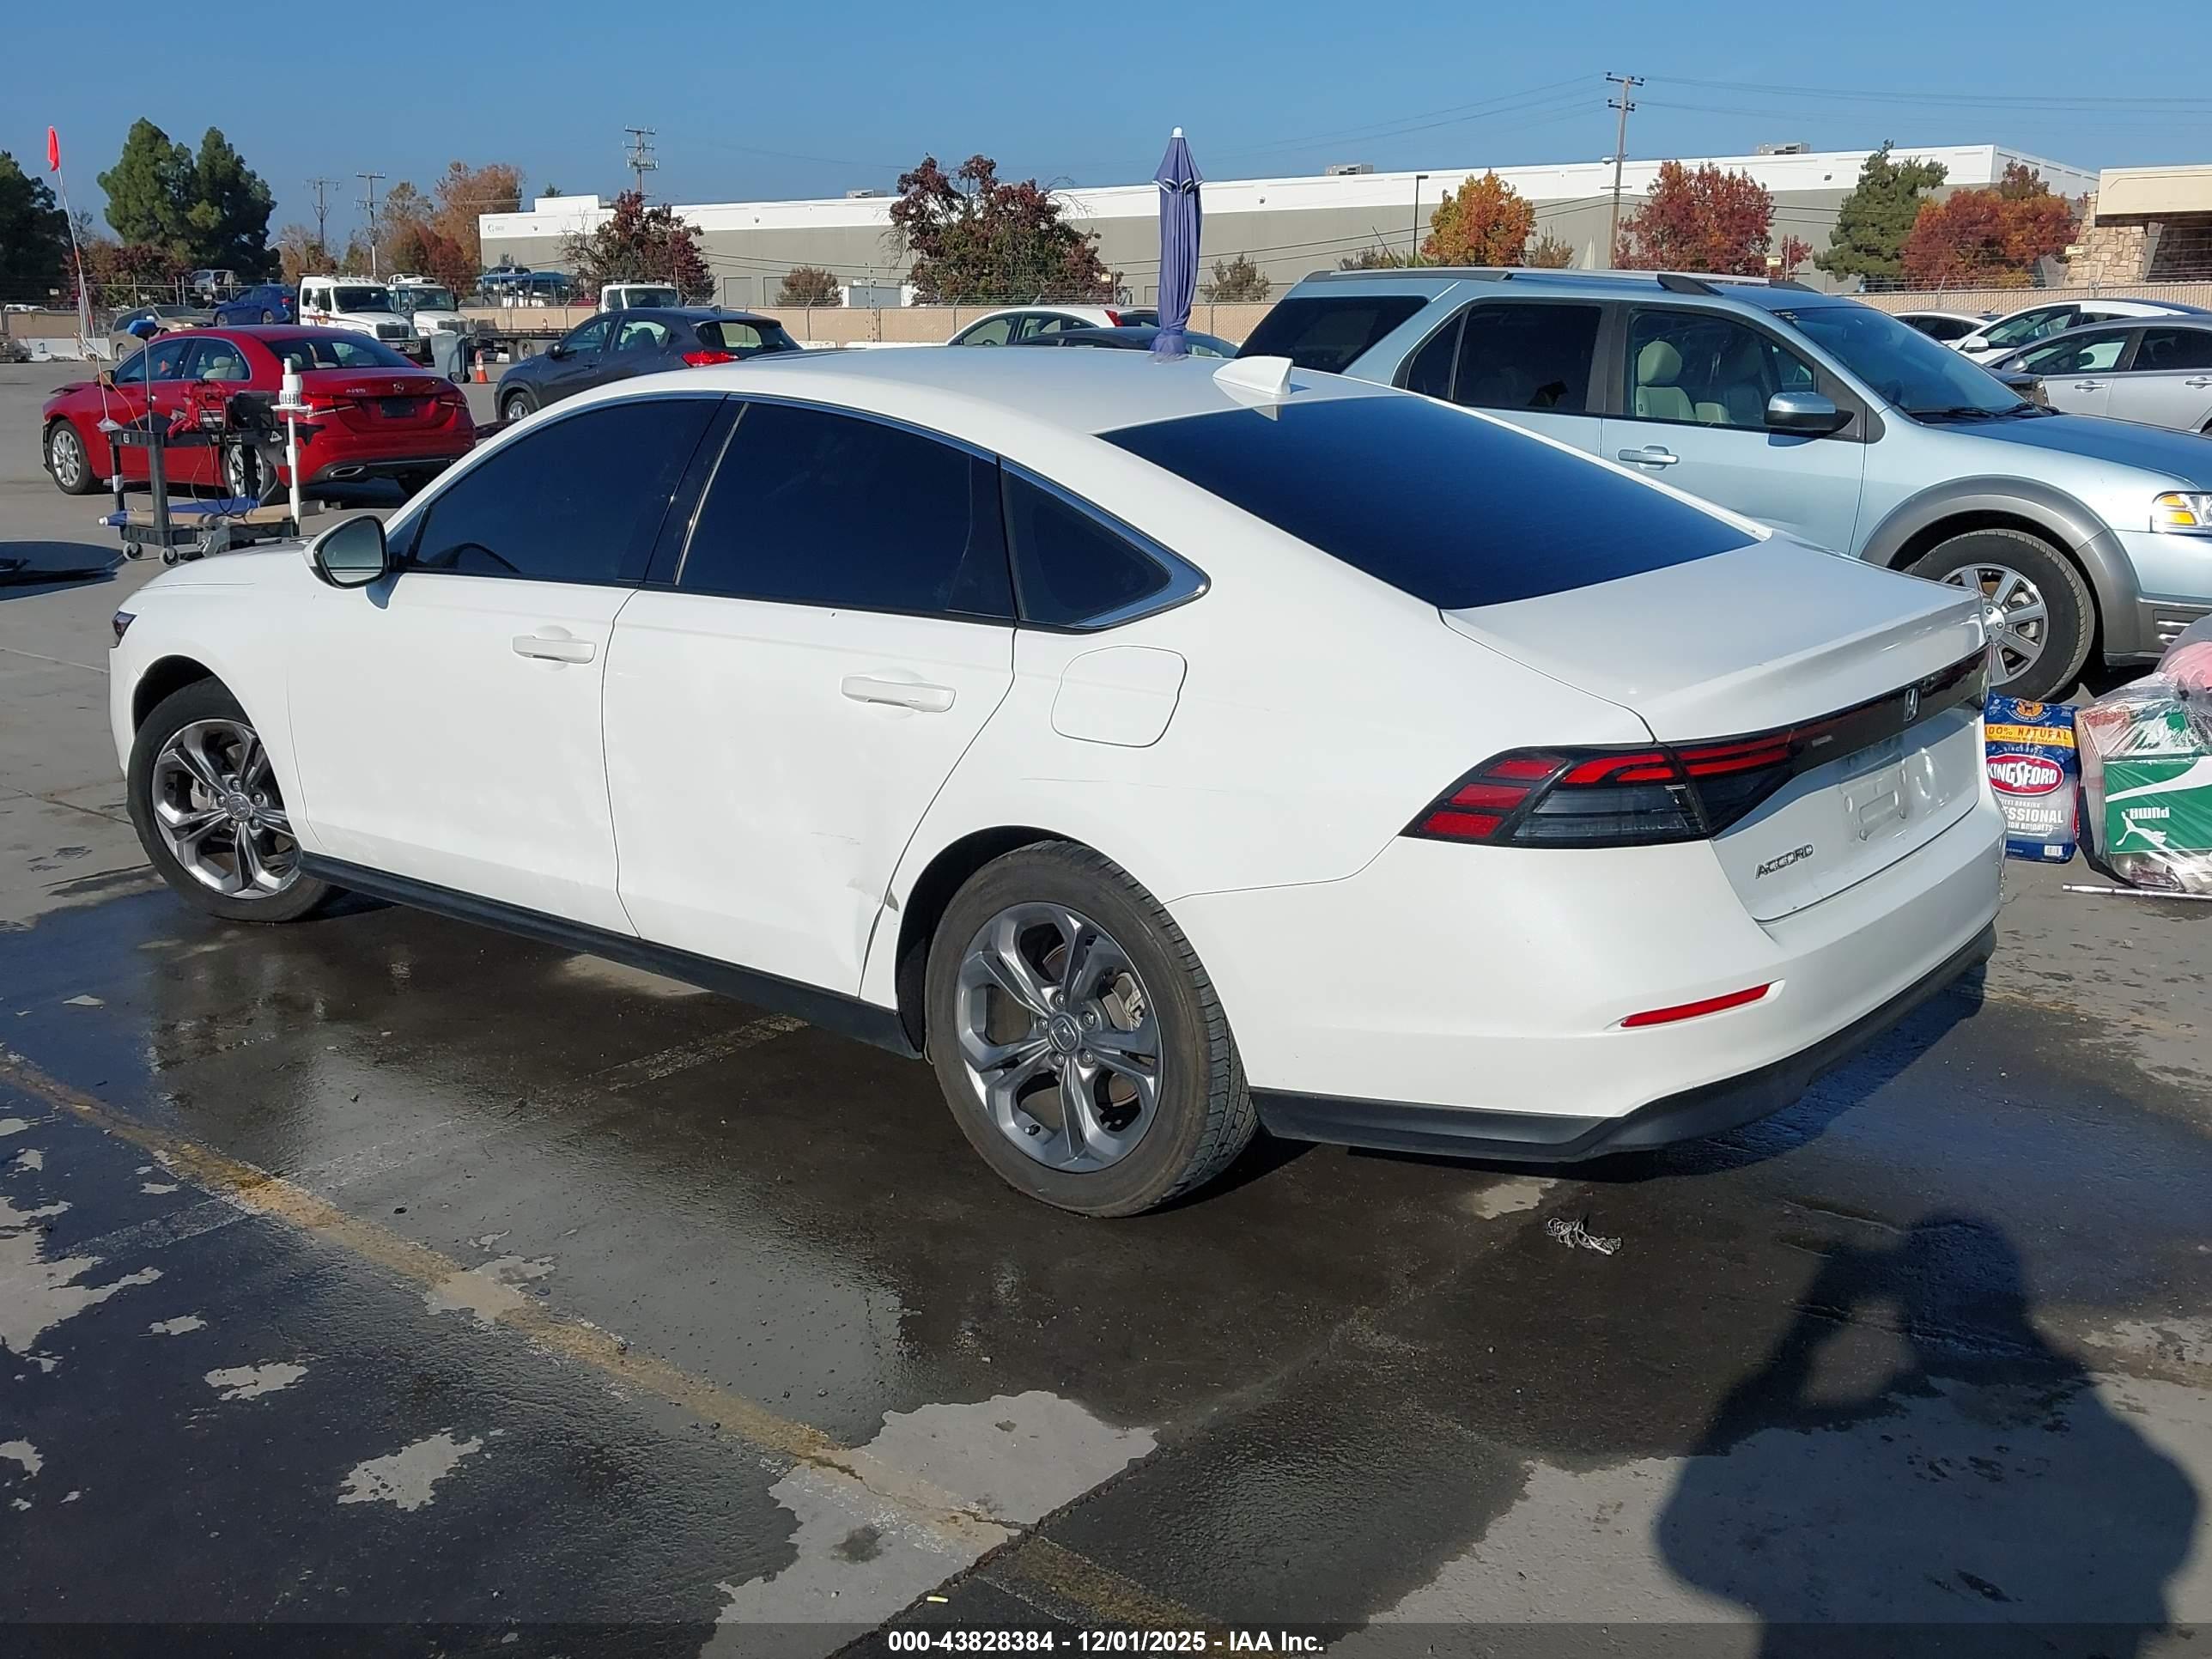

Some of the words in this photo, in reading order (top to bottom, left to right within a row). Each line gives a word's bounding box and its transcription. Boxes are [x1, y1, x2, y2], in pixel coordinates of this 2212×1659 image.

[2018, 727, 2069, 740] NATURAL
[1986, 761, 2057, 787] KINGSFORD
[2130, 807, 2170, 819] PUMA
[1755, 844, 1814, 879] ACCORD
